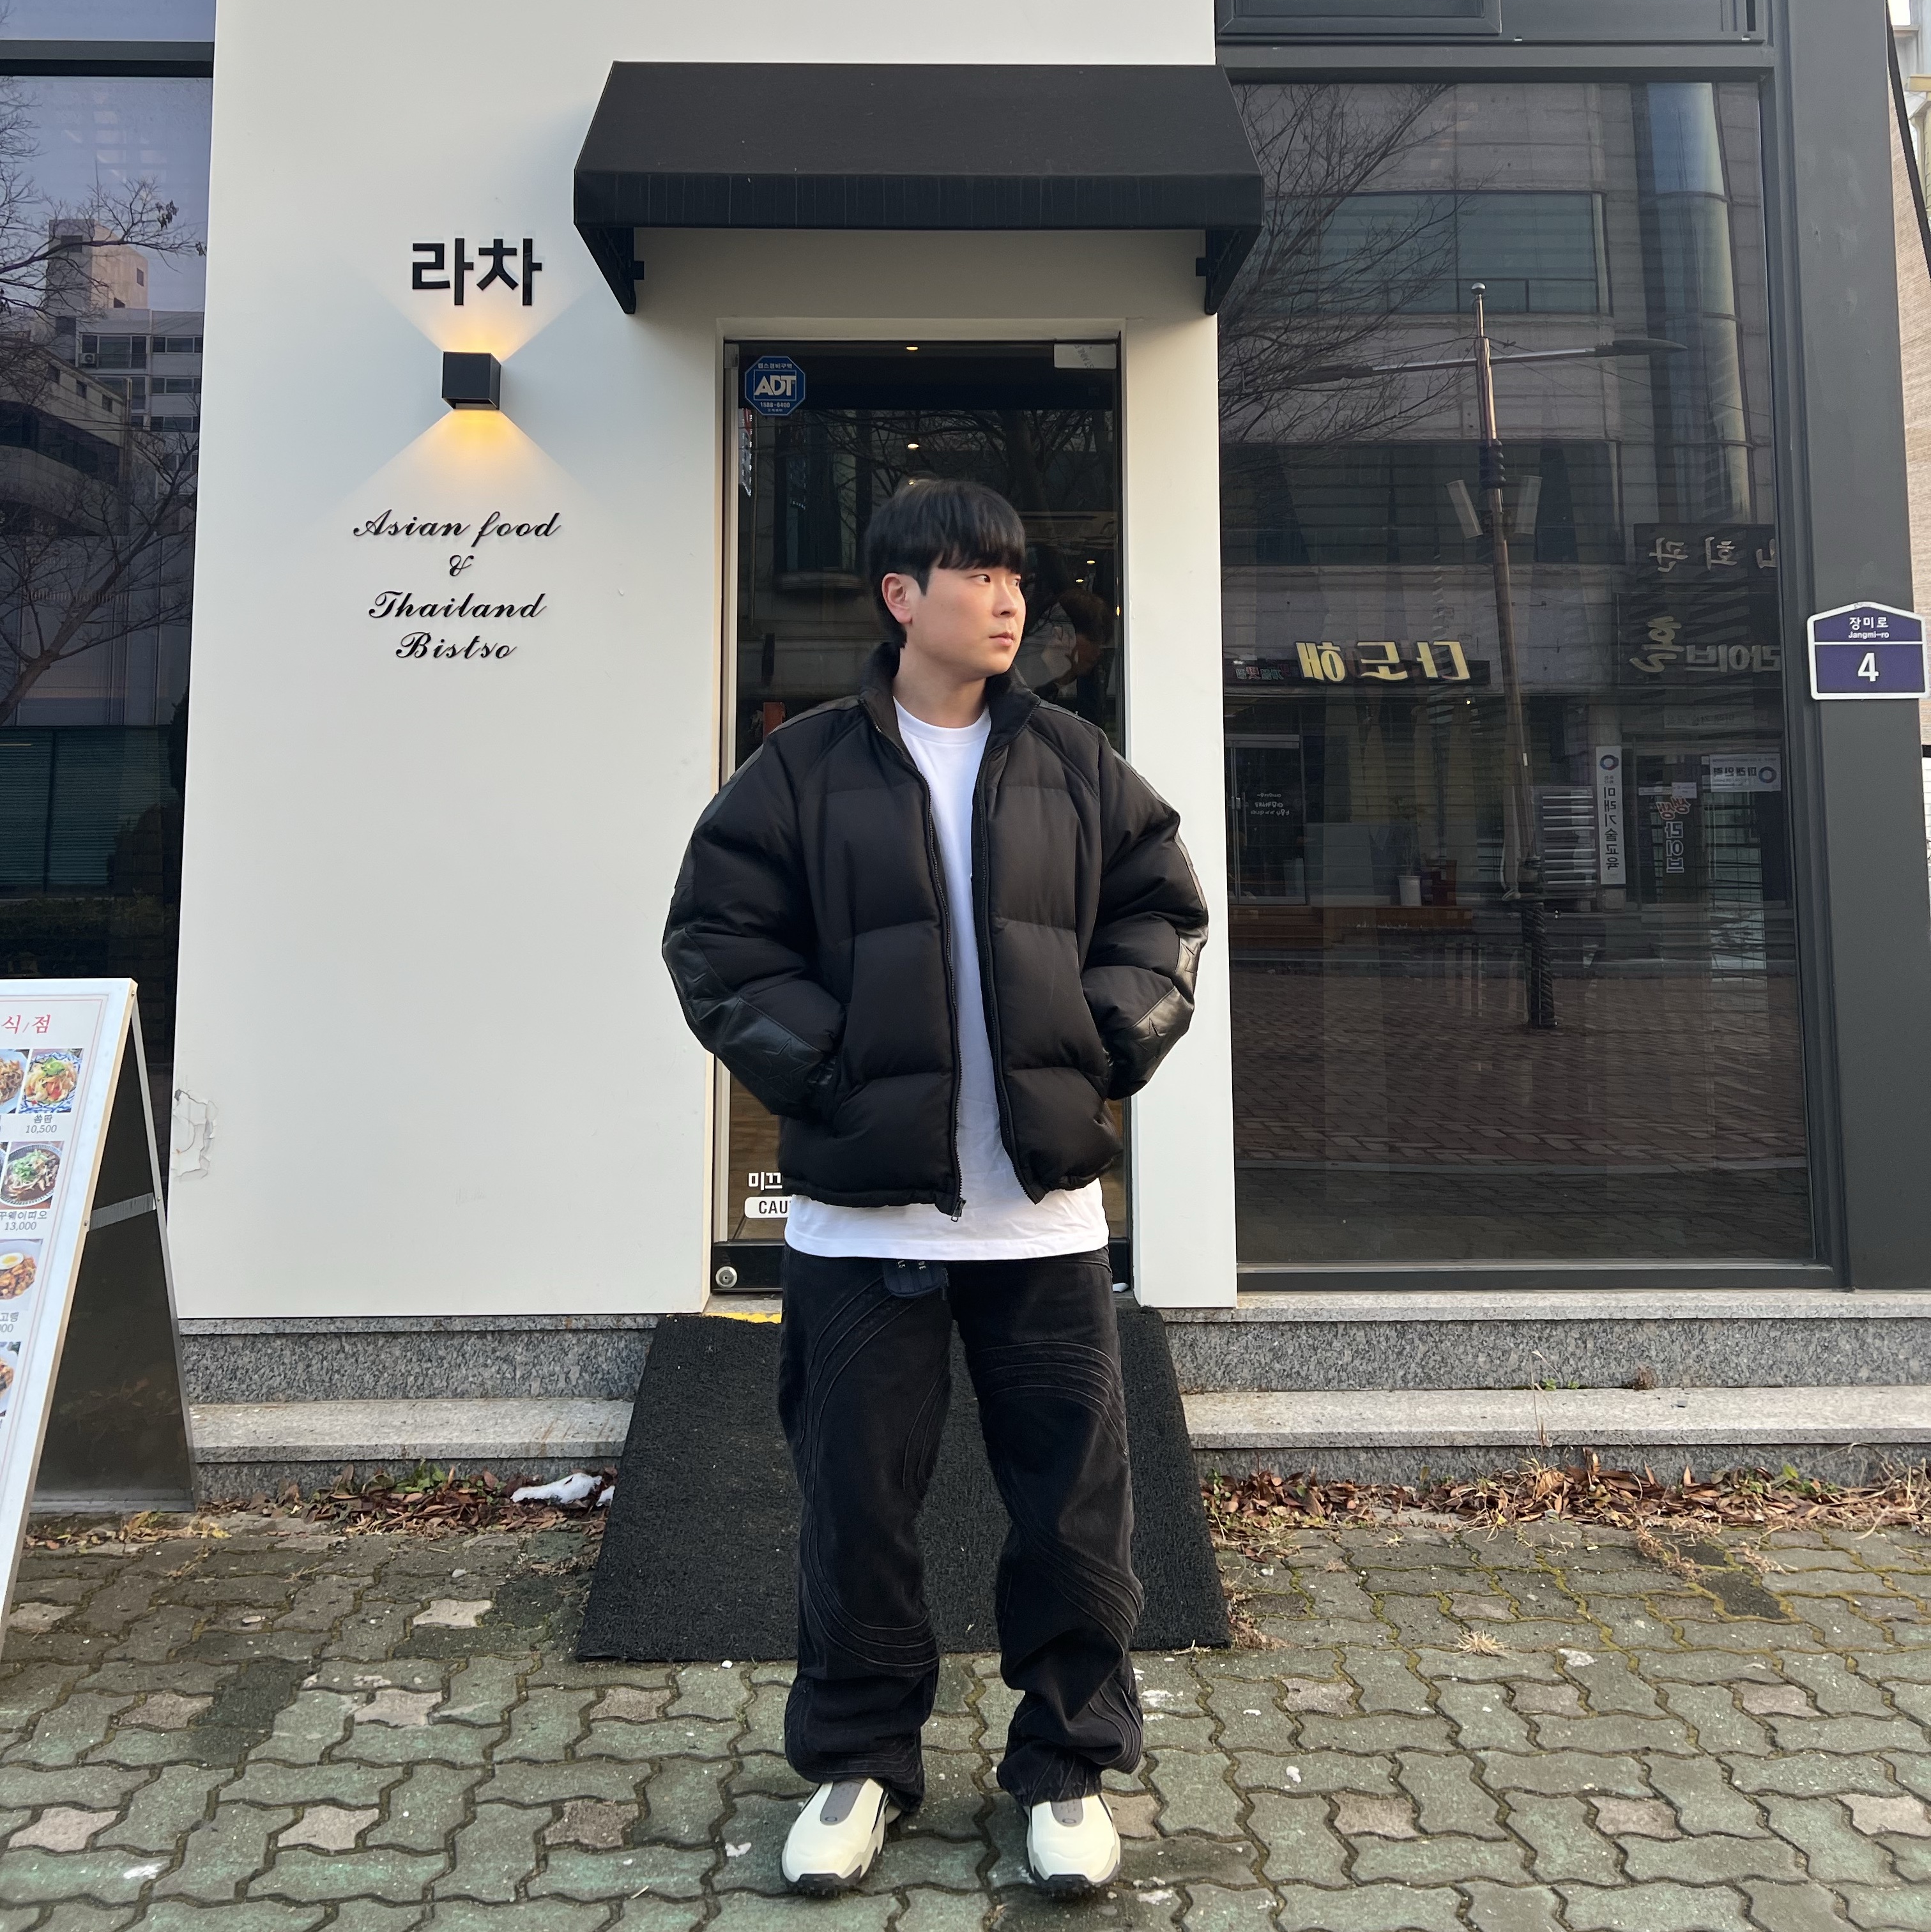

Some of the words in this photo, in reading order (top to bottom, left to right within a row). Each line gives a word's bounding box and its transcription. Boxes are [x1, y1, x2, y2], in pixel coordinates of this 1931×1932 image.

[411, 238, 542, 305] 라차
[754, 375, 797, 396] ADT
[353, 509, 469, 536] Asian
[471, 511, 561, 547] food
[448, 554, 474, 577] &
[369, 590, 547, 619] Thailand
[1849, 616, 1889, 630] 장미로
[1848, 631, 1889, 639] Jangmi-ro
[1858, 652, 1879, 682] 4
[26, 1125, 57, 1134] 10,500
[759, 1201, 791, 1214] CAU
[4, 1221, 37, 1231] 13,000
